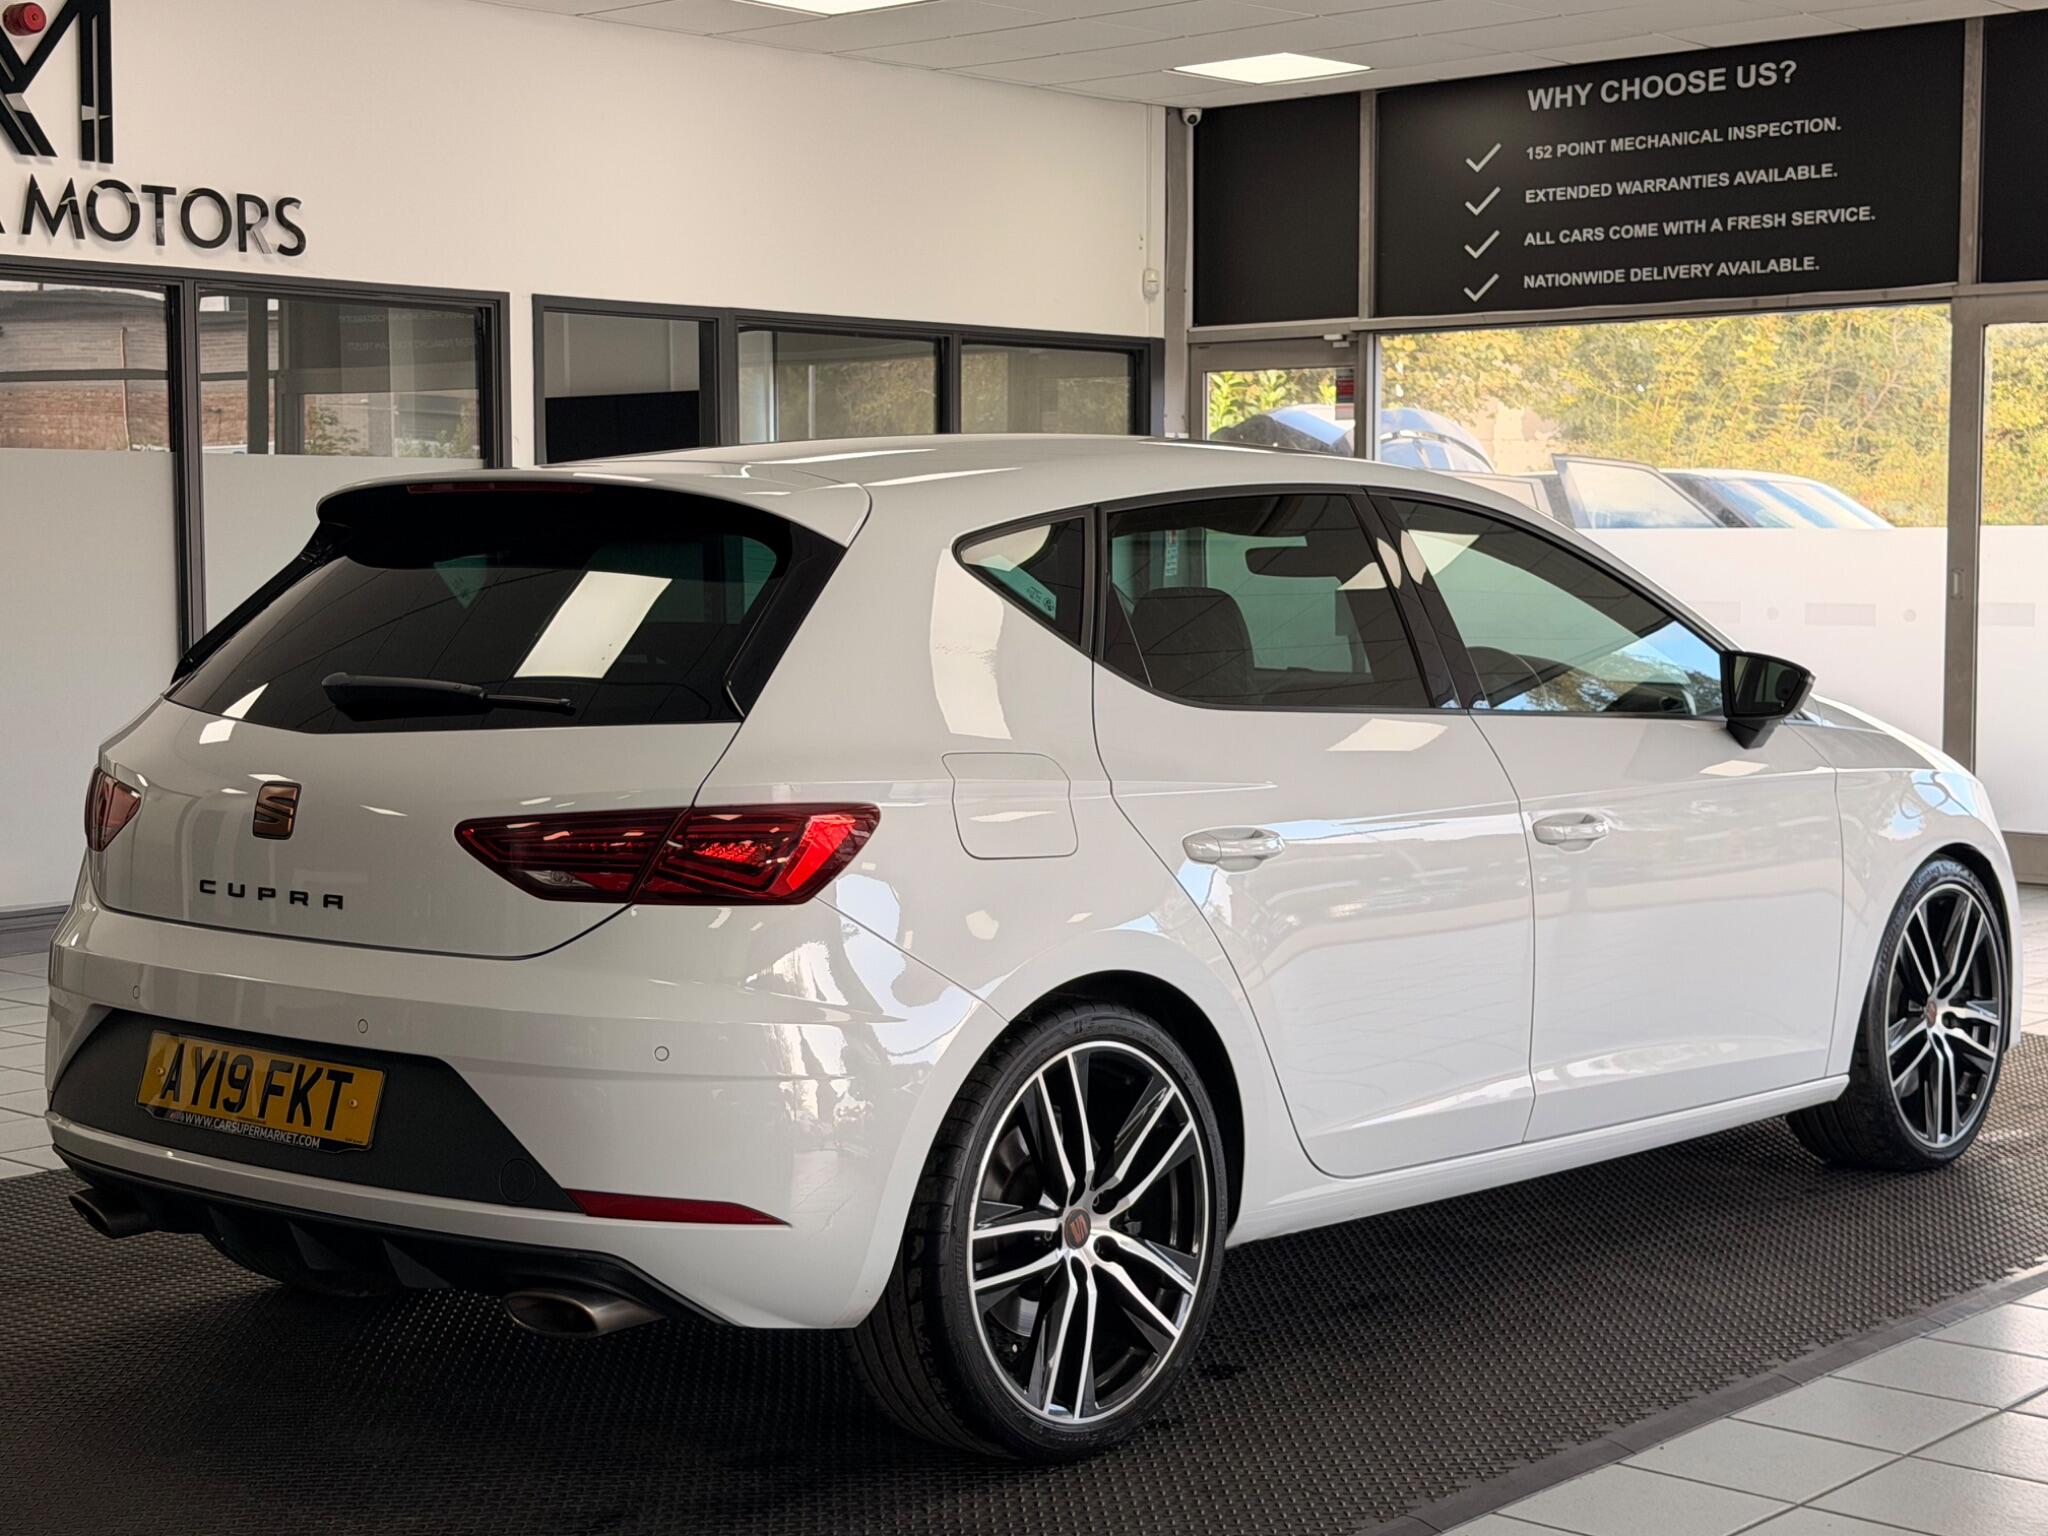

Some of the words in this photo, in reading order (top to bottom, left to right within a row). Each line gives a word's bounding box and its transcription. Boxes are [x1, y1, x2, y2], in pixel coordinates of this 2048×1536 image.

[1527, 83, 1593, 112] WHY
[1600, 68, 1727, 103] CHOOSE
[1737, 60, 1797, 88] US?
[1526, 144, 1553, 161] 152
[1556, 139, 1607, 158] POINT
[1610, 129, 1723, 152] MECHANICAL
[1727, 116, 1842, 141] INSPECTION.
[1525, 183, 1612, 204] EXTENDED
[1616, 172, 1730, 195] WARRANTIES
[1733, 163, 1838, 186] AVAILABLE.
[21, 173, 307, 257] MOTORS
[1524, 231, 1556, 247] ALL
[1559, 227, 1605, 244] CARS
[1609, 222, 1659, 240] COME
[1662, 219, 1706, 236] WITH
[1710, 218, 1723, 232] A
[1727, 213, 1787, 231] FRESH
[1791, 206, 1876, 226] SERVICE.
[1523, 269, 1626, 289] NATIONWIDE
[1630, 263, 1714, 283] DELIVERY
[1716, 256, 1820, 276] AVAILABLE.
[199, 879, 344, 910] CUPRA
[184, 1112, 321, 1149] WWW.CARSUPERMARKET.COM
